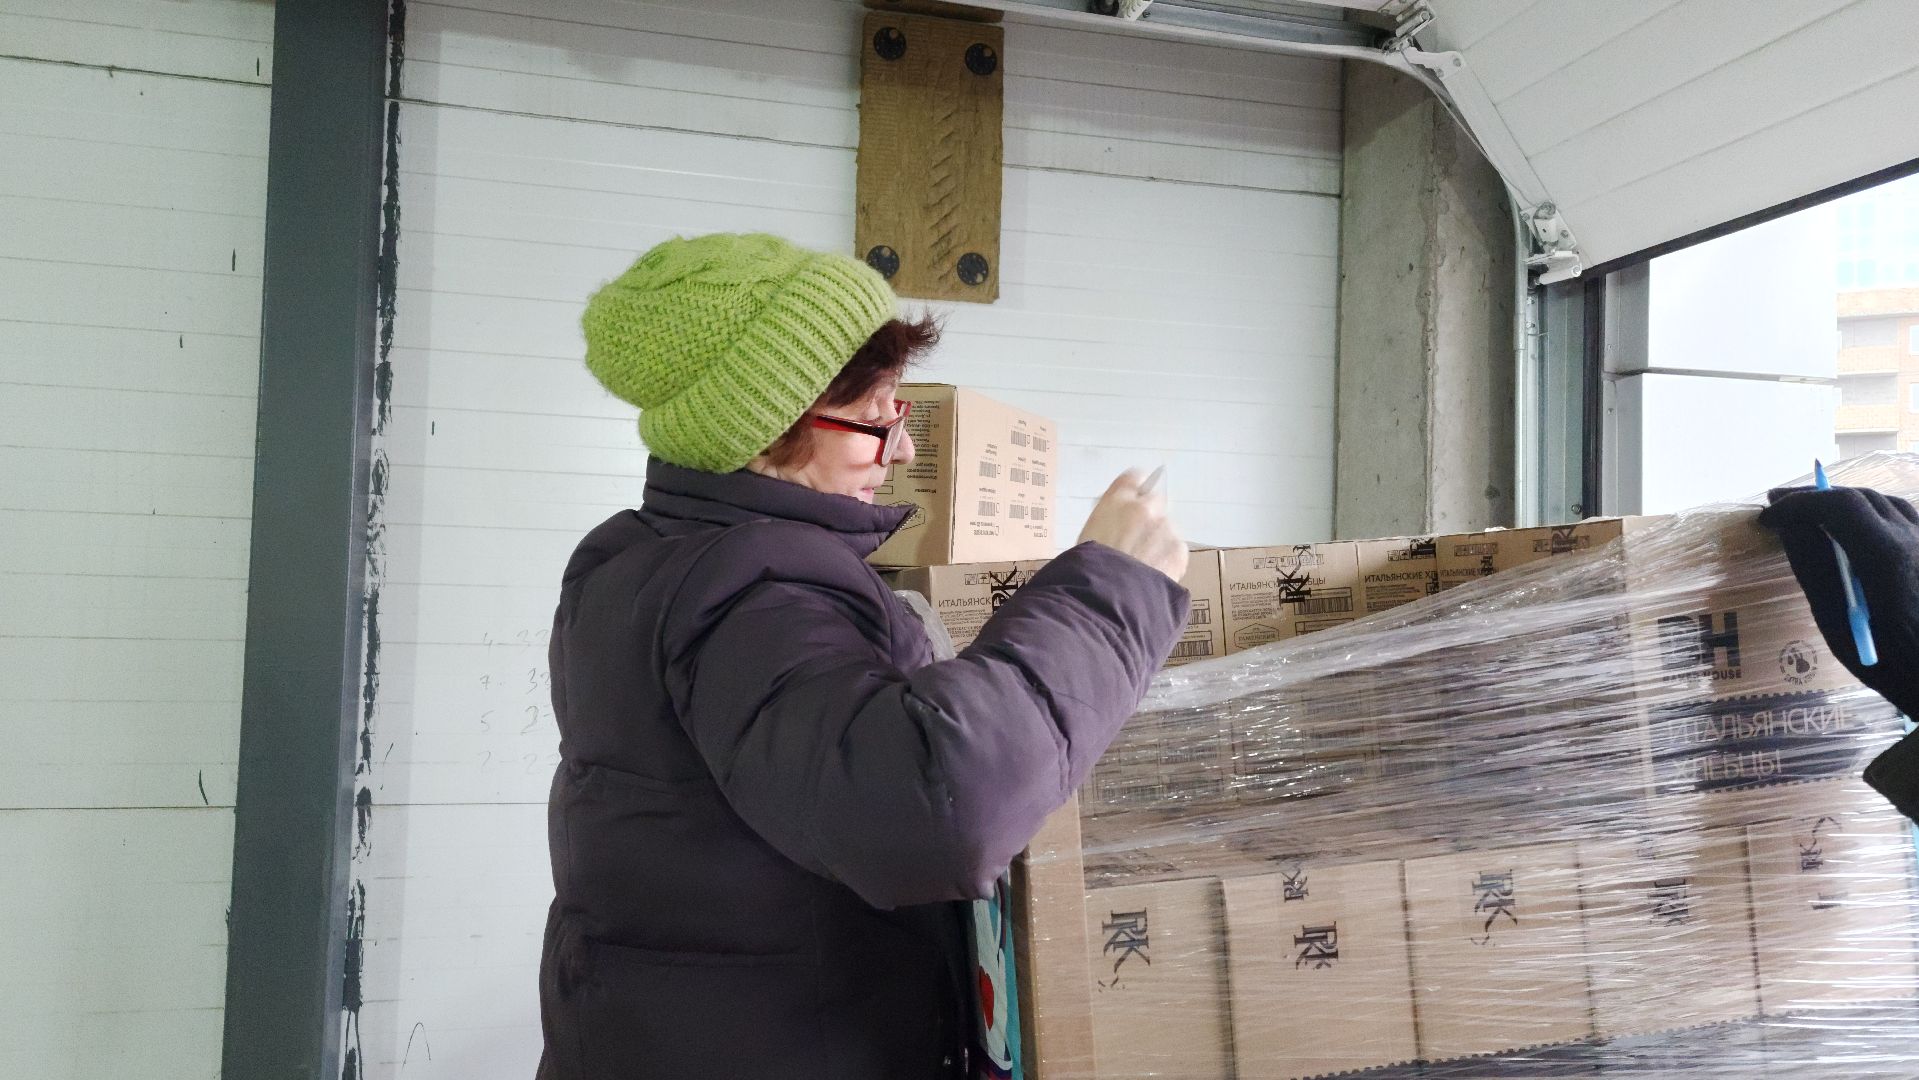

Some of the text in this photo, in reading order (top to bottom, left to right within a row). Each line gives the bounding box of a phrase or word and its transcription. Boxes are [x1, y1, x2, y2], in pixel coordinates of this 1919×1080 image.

[1364, 571, 1423, 583] ИТАЛЬЯНСКИЕ
[1229, 580, 1278, 591] ИТАЛЬЯНСК
[938, 597, 991, 608] ИТАЛЬЯНСК
